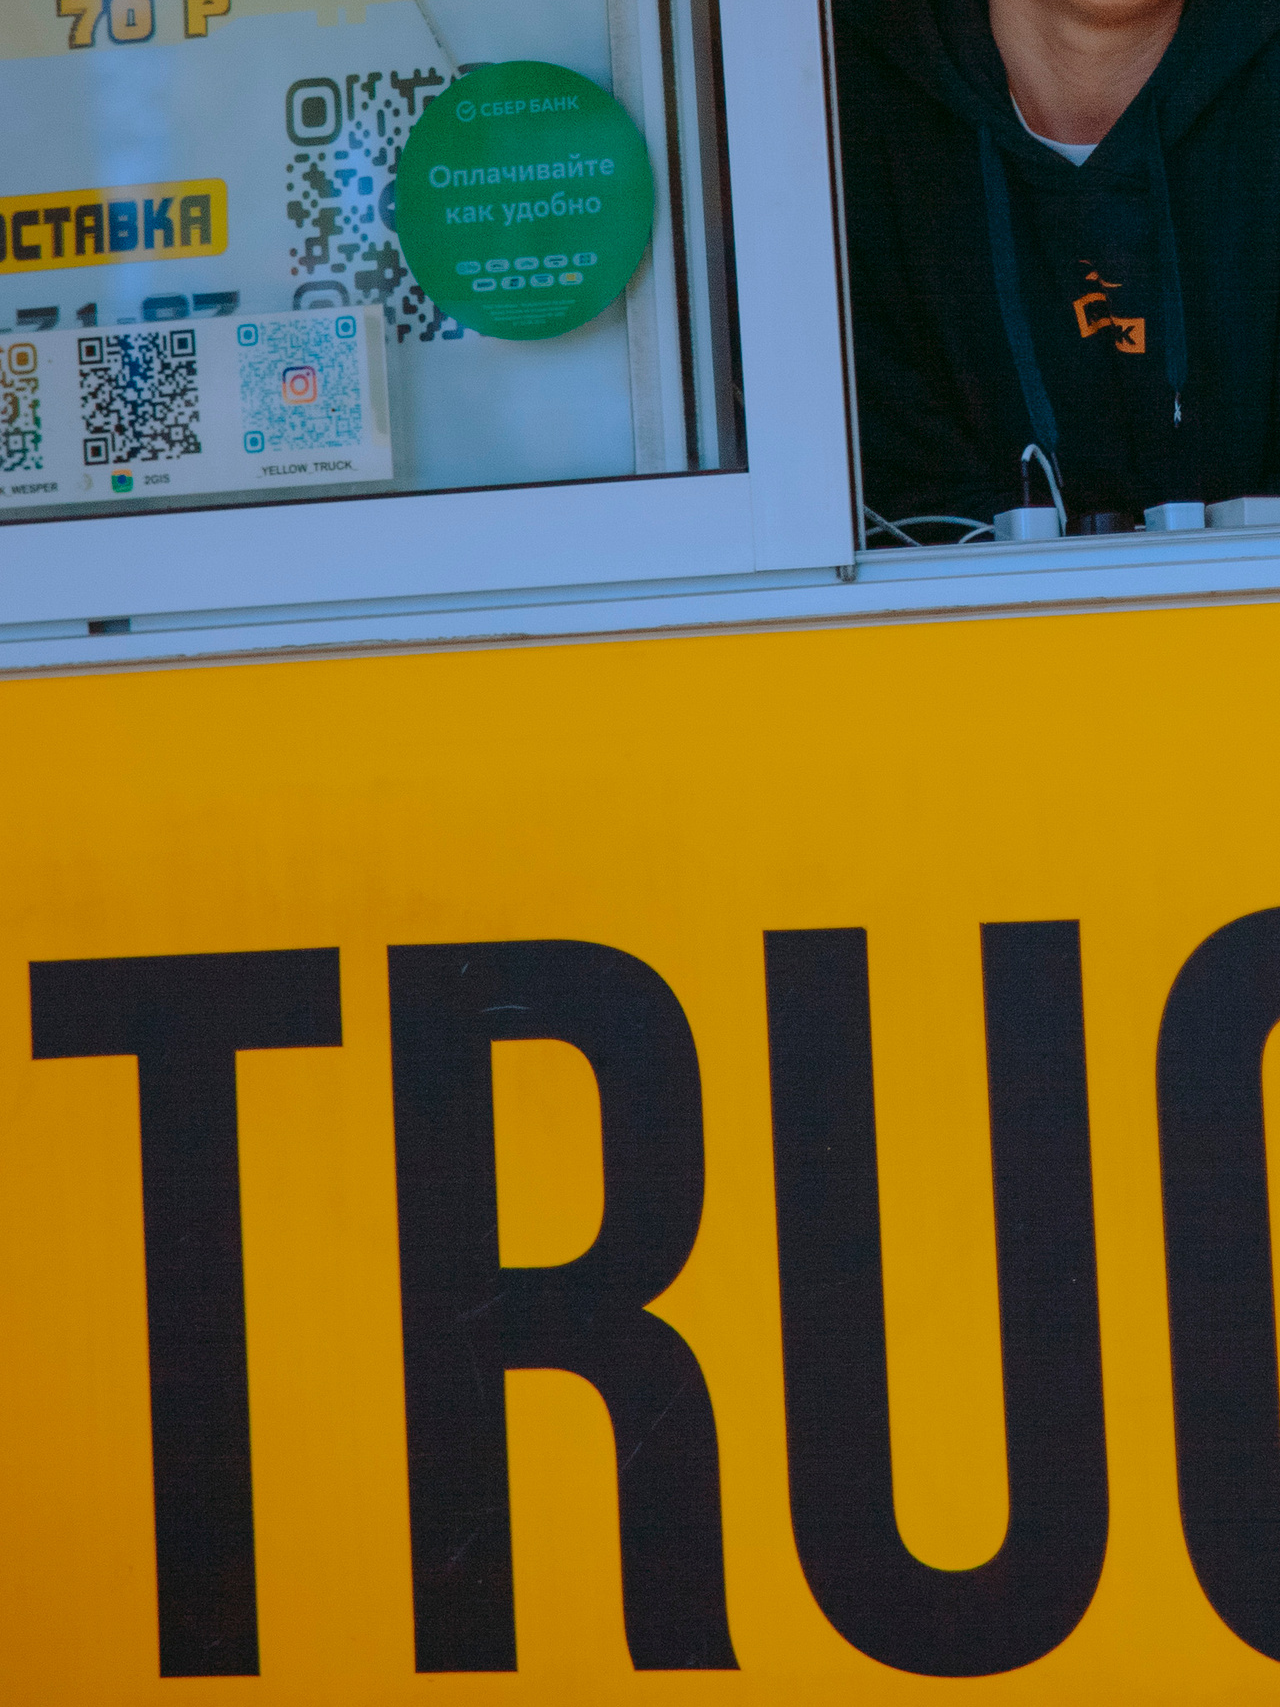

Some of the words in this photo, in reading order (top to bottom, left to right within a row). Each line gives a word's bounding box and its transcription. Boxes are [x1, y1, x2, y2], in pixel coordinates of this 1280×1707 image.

[480, 100, 526, 117] СБЕР
[530, 95, 580, 114] БАНК
[429, 153, 615, 188] Оплачивайте
[446, 204, 494, 225] как
[501, 191, 601, 226] удобно
[0, 194, 212, 263] СТАВКА
